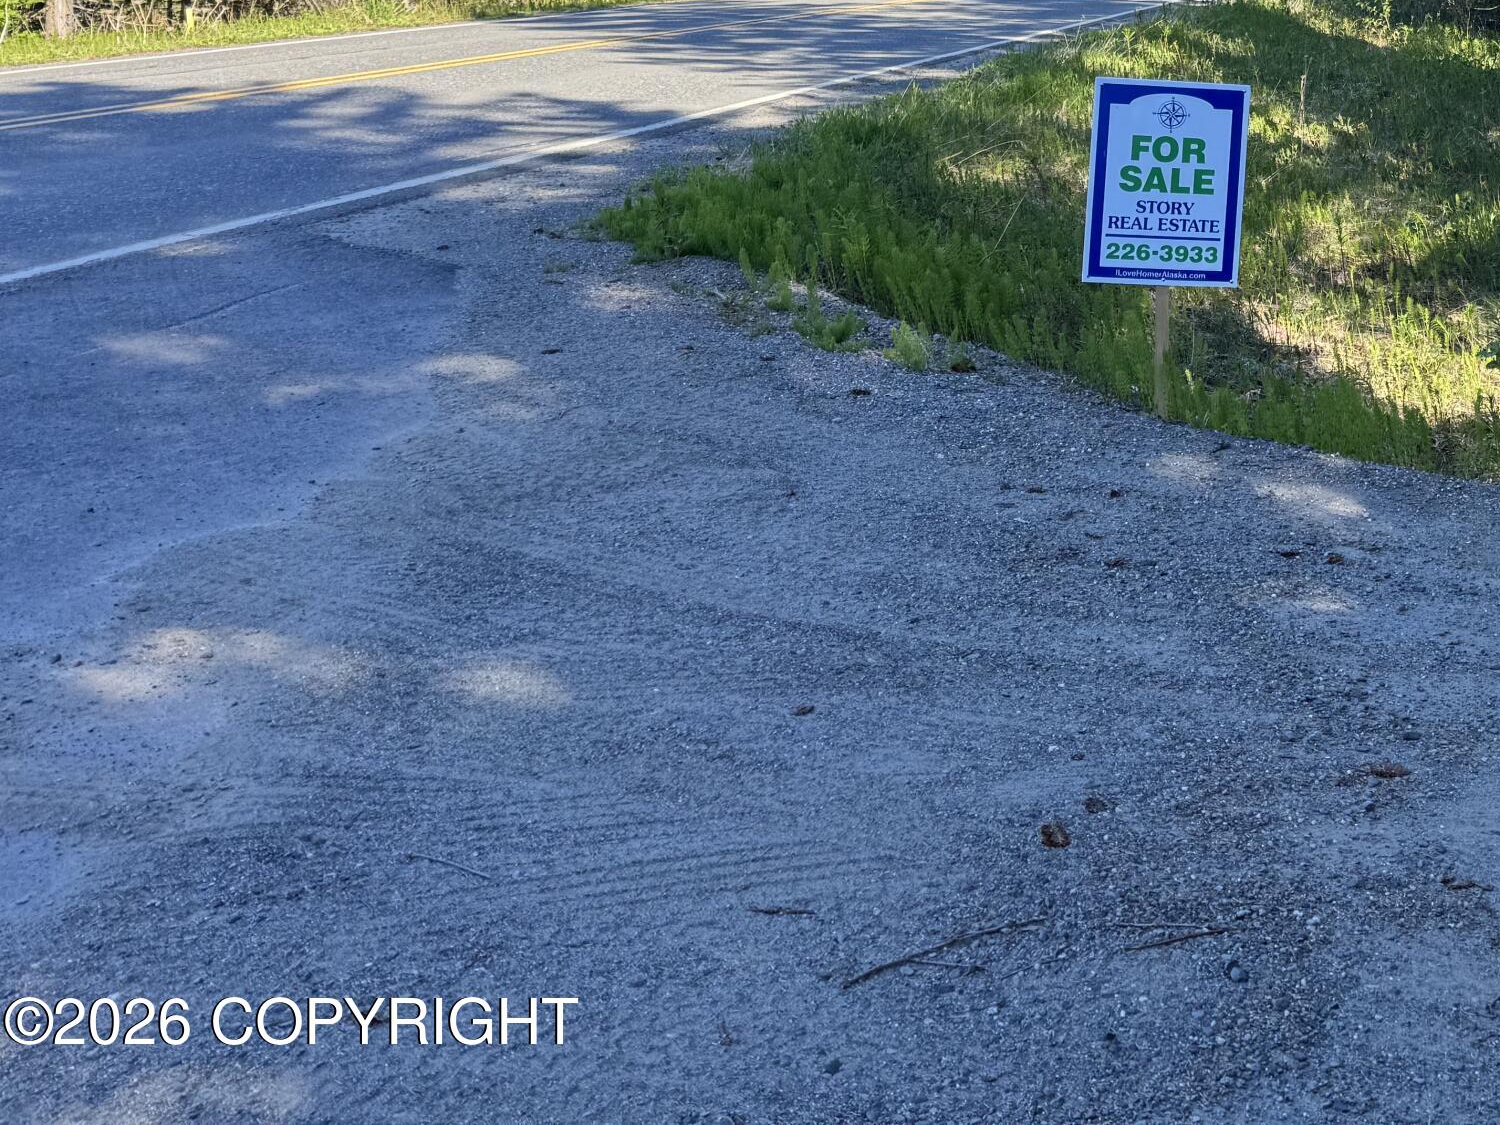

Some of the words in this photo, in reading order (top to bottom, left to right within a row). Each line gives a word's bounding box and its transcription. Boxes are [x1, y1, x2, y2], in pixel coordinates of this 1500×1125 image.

[1131, 135, 1206, 164] FOR
[1119, 166, 1215, 195] SALE
[1135, 200, 1195, 215] STORY
[1107, 216, 1153, 231] REAL
[1158, 218, 1220, 234] ESTATE
[1105, 242, 1218, 264] 226-3933
